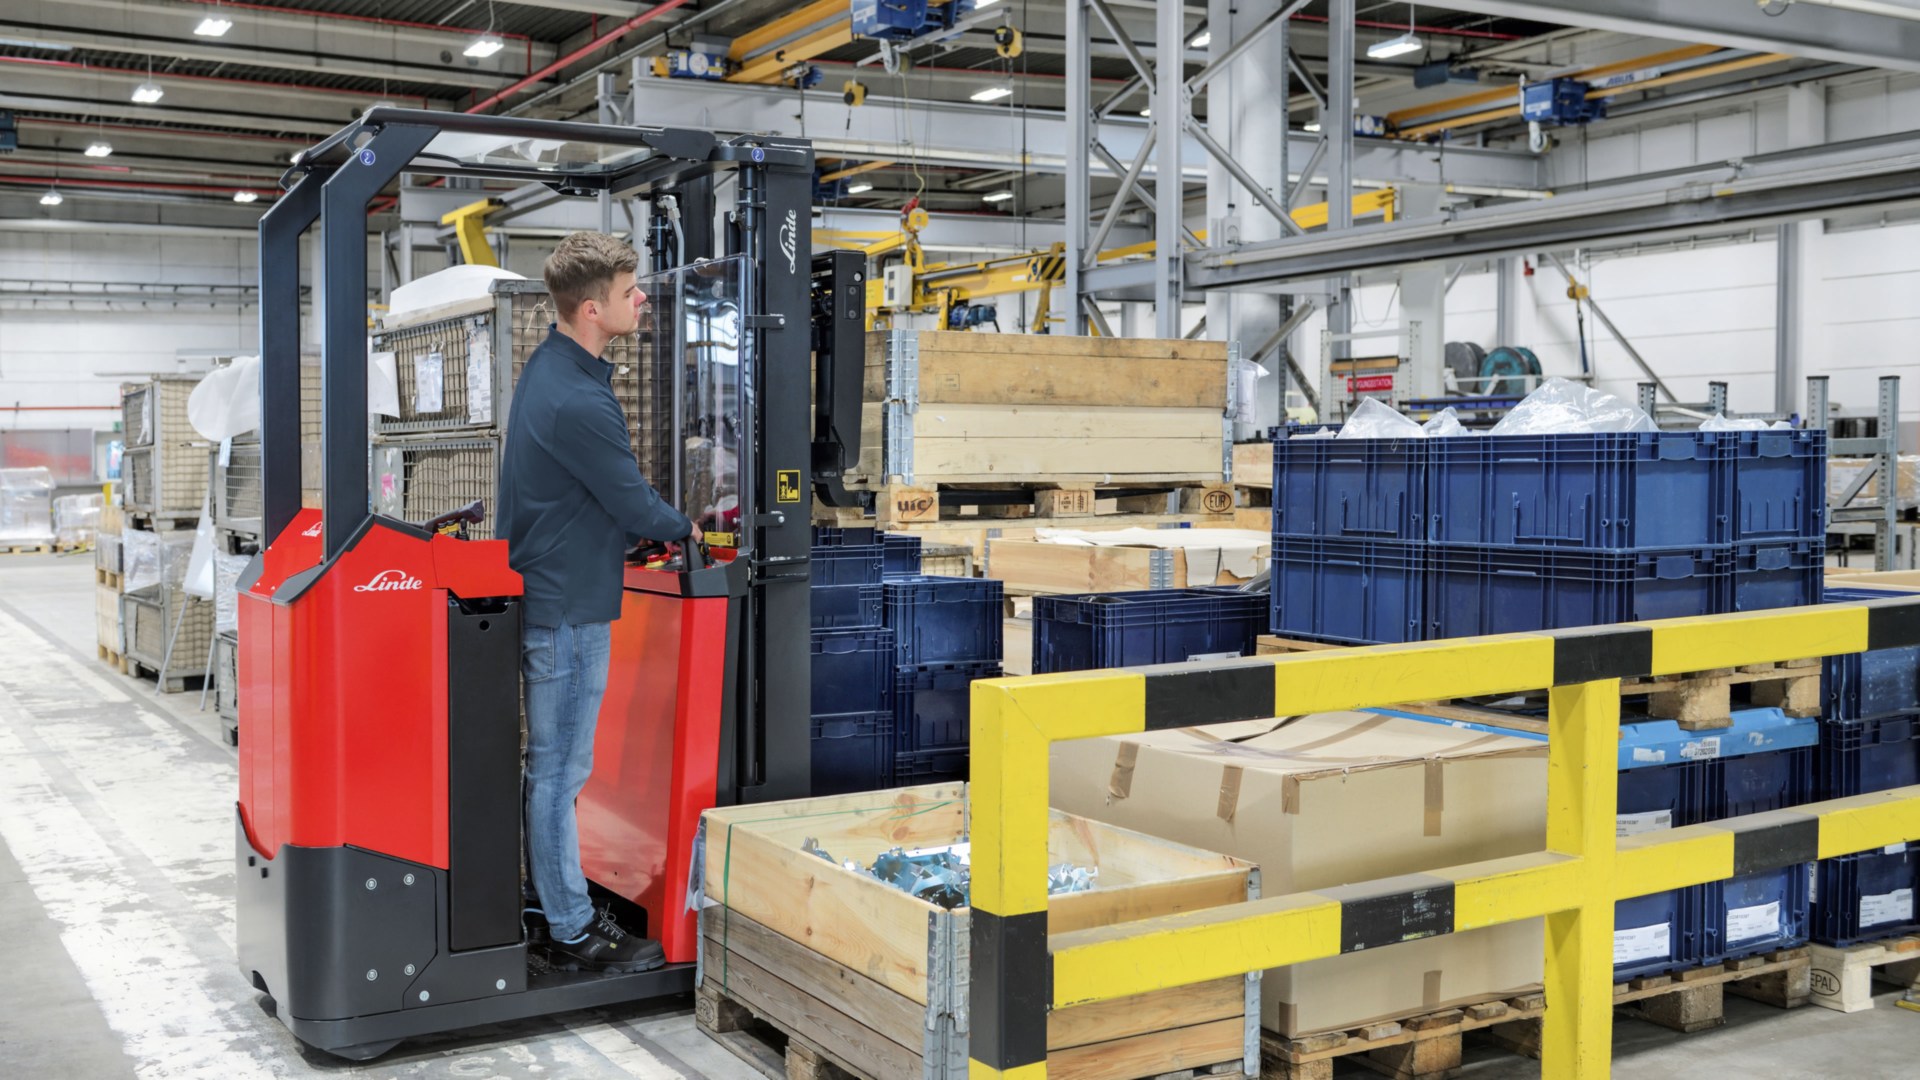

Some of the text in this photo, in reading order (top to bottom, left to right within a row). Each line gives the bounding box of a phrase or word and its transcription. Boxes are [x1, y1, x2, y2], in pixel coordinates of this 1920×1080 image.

[779, 209, 797, 274] Linde
[1209, 494, 1226, 509] EUR
[353, 569, 423, 592] Linde
[1810, 972, 1836, 992] EPAL
